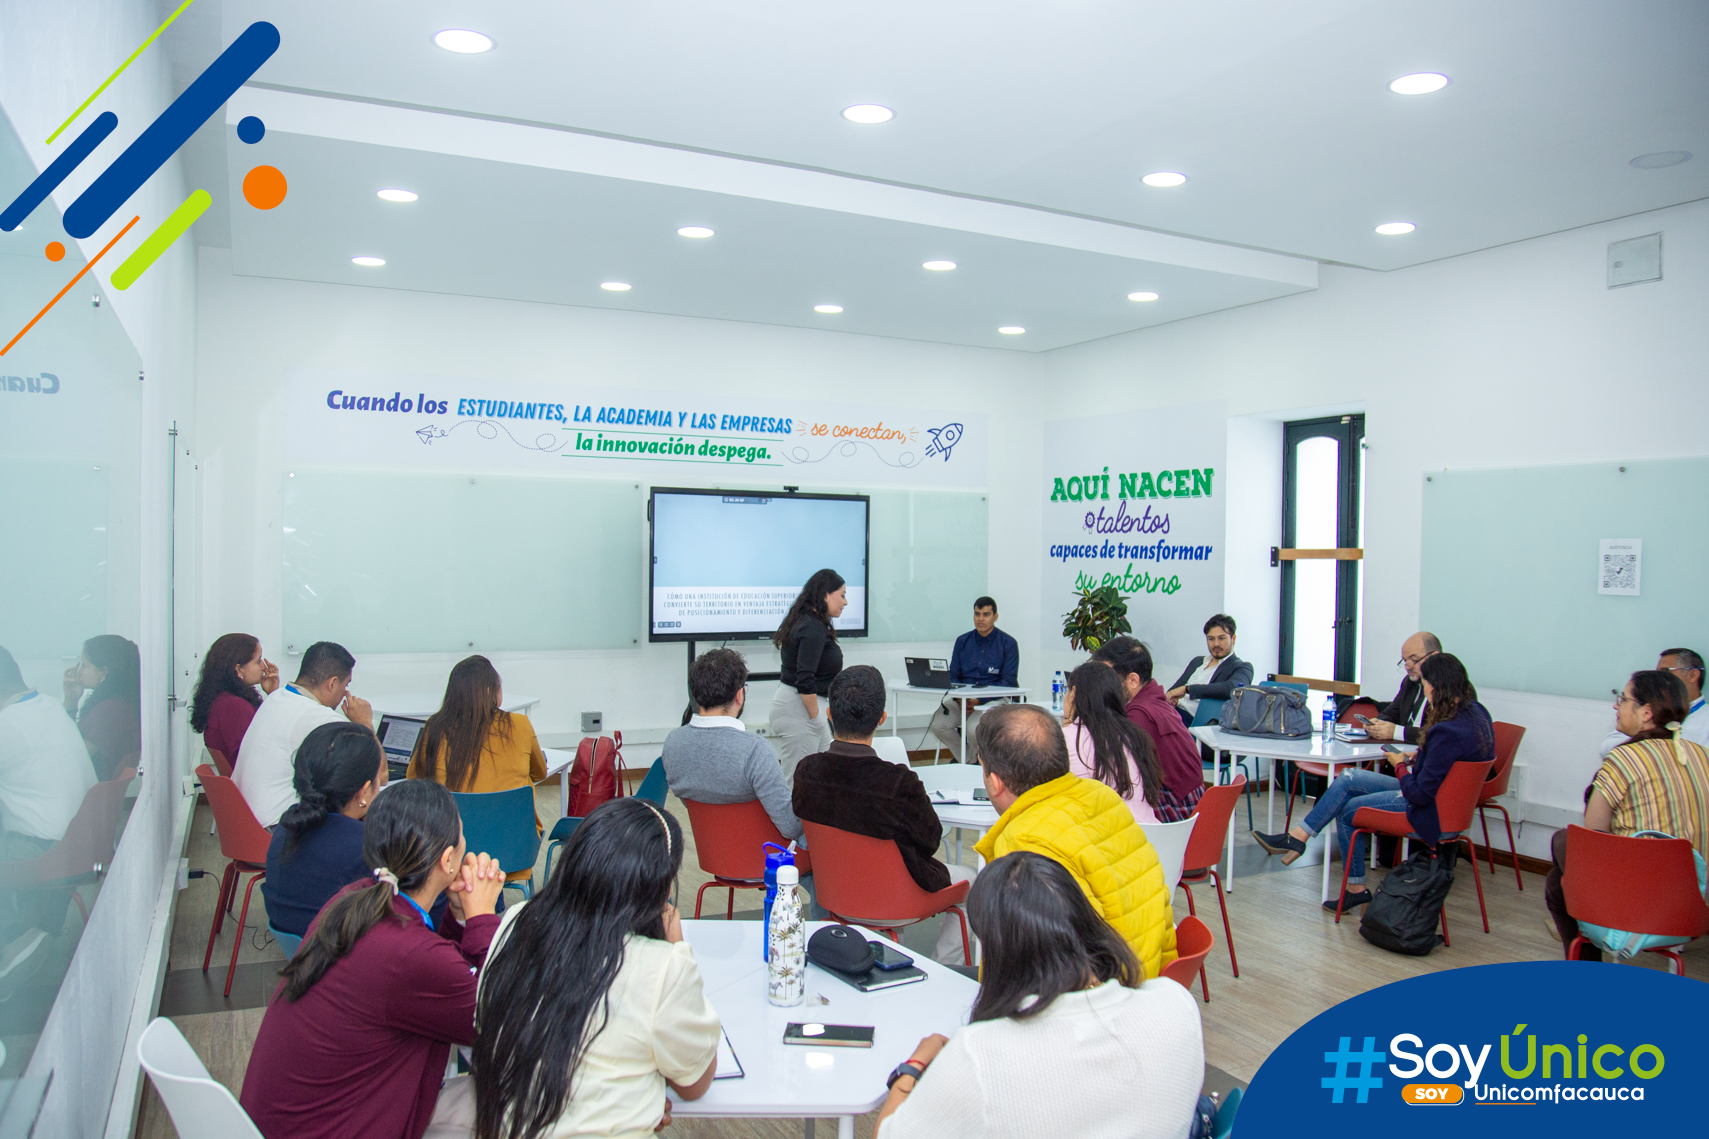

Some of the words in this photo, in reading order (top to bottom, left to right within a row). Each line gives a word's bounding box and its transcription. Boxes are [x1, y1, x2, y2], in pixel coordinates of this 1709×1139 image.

[327, 390, 413, 413] Cuando
[417, 393, 448, 414] los
[457, 398, 568, 424] ESTUDIANTES,
[573, 405, 592, 423] LA
[596, 407, 673, 427] ACADEMIA
[677, 412, 688, 428] Y
[691, 412, 717, 430] LAS
[721, 414, 793, 434] EMPRESAS
[811, 422, 830, 436] se
[832, 421, 908, 444] conectan,
[576, 432, 592, 451] la
[596, 433, 696, 456] innovación
[698, 438, 772, 462] despega.
[1050, 466, 1110, 503] AQUÍ
[1118, 468, 1215, 500] NACEN
[1096, 500, 1170, 534] talentos
[1050, 539, 1098, 562] capaces
[1099, 539, 1115, 559] de
[1117, 539, 1213, 562] transformar
[1075, 570, 1097, 591] su
[1101, 562, 1182, 595] entorno
[667, 592, 683, 600] CÓMO
[697, 592, 731, 600] INSTITUCIÓN
[740, 592, 770, 600] EDUCACIÓN
[742, 607, 785, 615] DIFERENCIACIÓN
